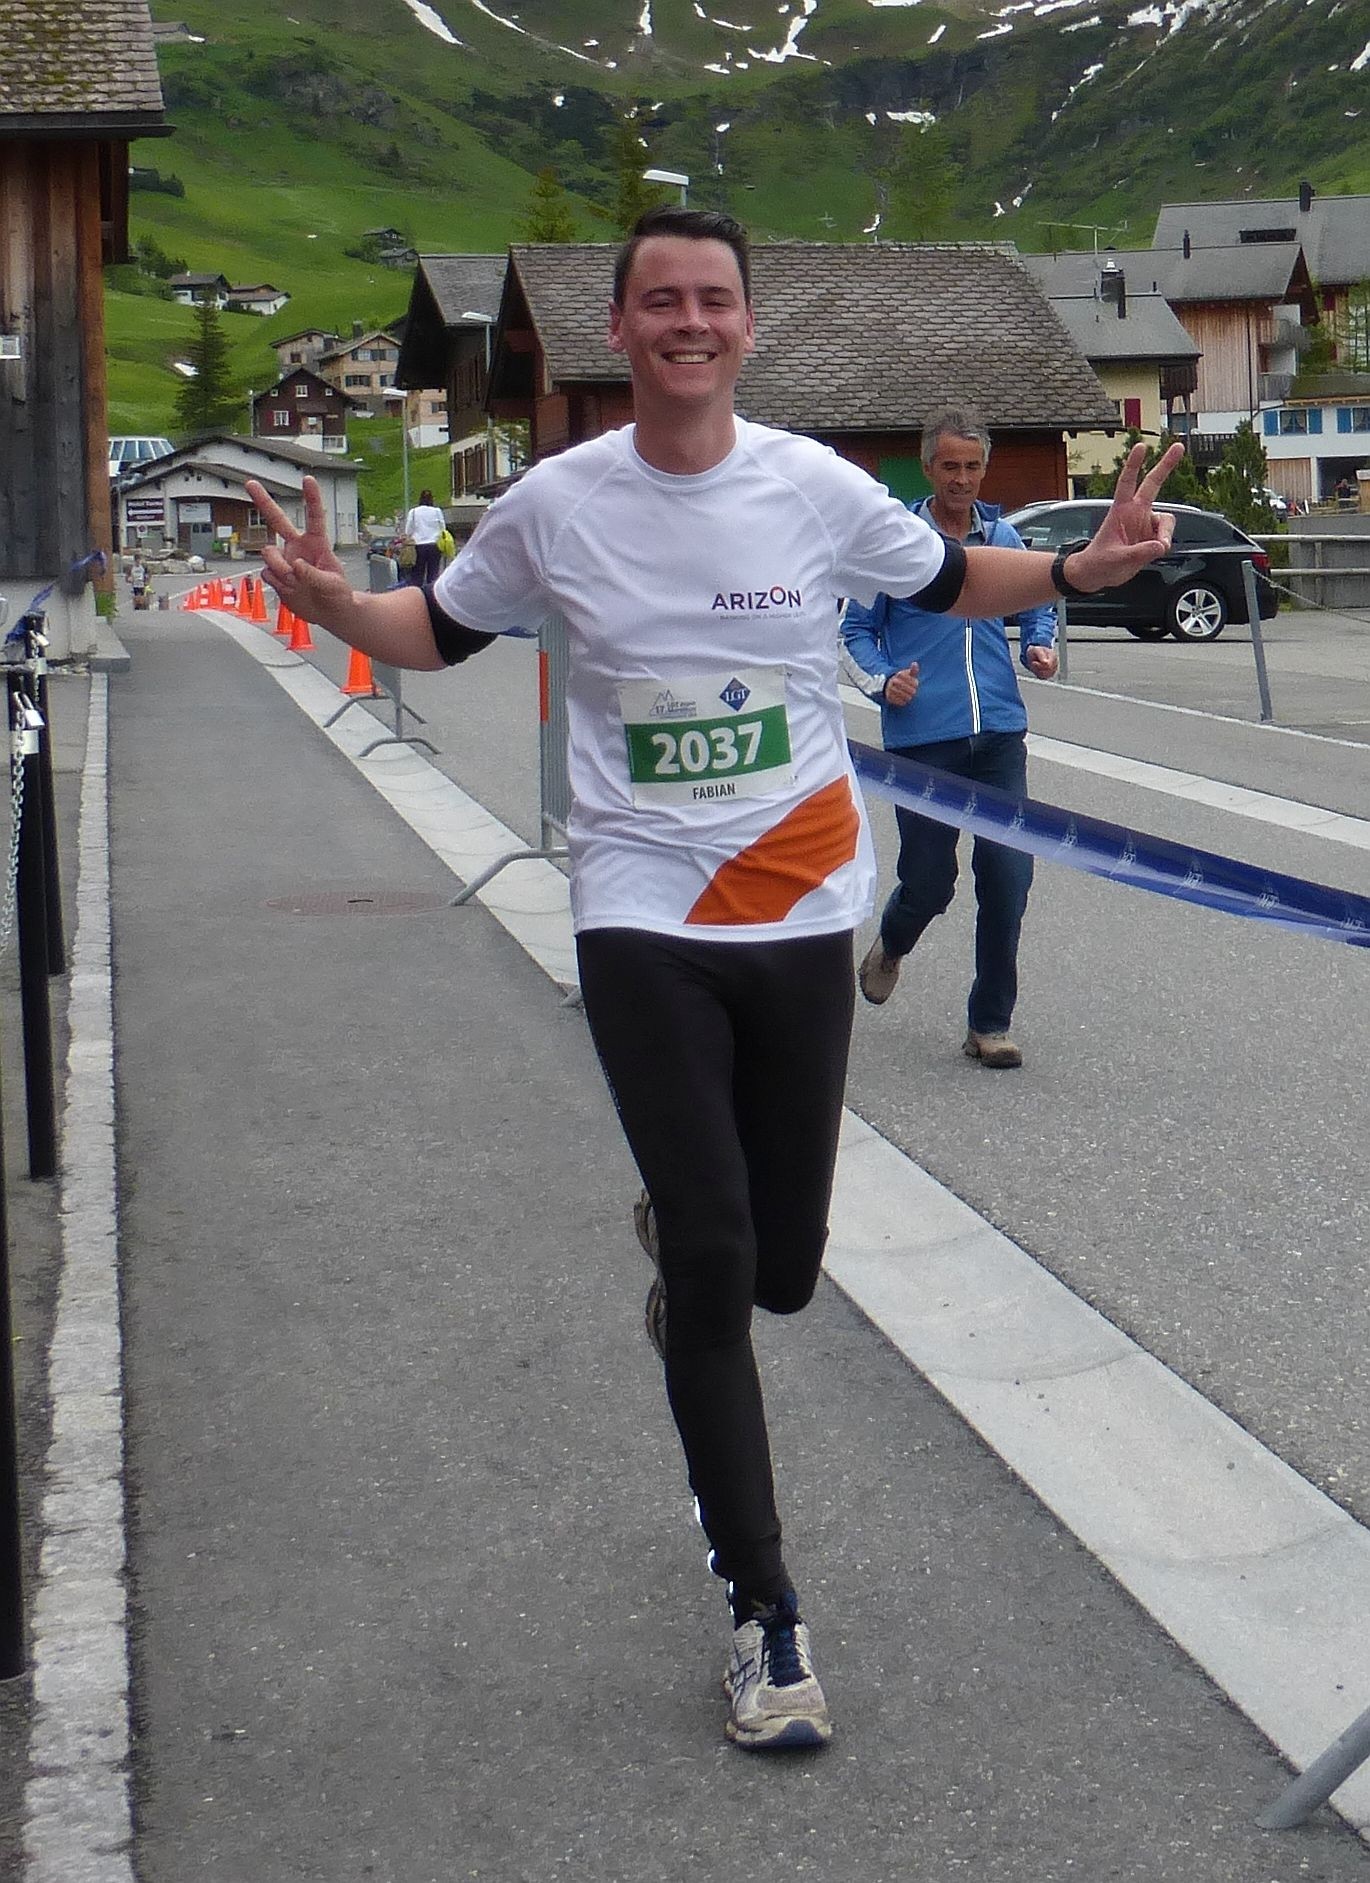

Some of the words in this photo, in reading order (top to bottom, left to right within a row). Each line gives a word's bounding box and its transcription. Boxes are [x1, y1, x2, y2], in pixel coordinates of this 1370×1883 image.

[711, 586, 802, 610] ARIZON
[725, 688, 747, 702] LGT
[651, 721, 763, 774] 2037
[693, 782, 736, 799] FABIAN
